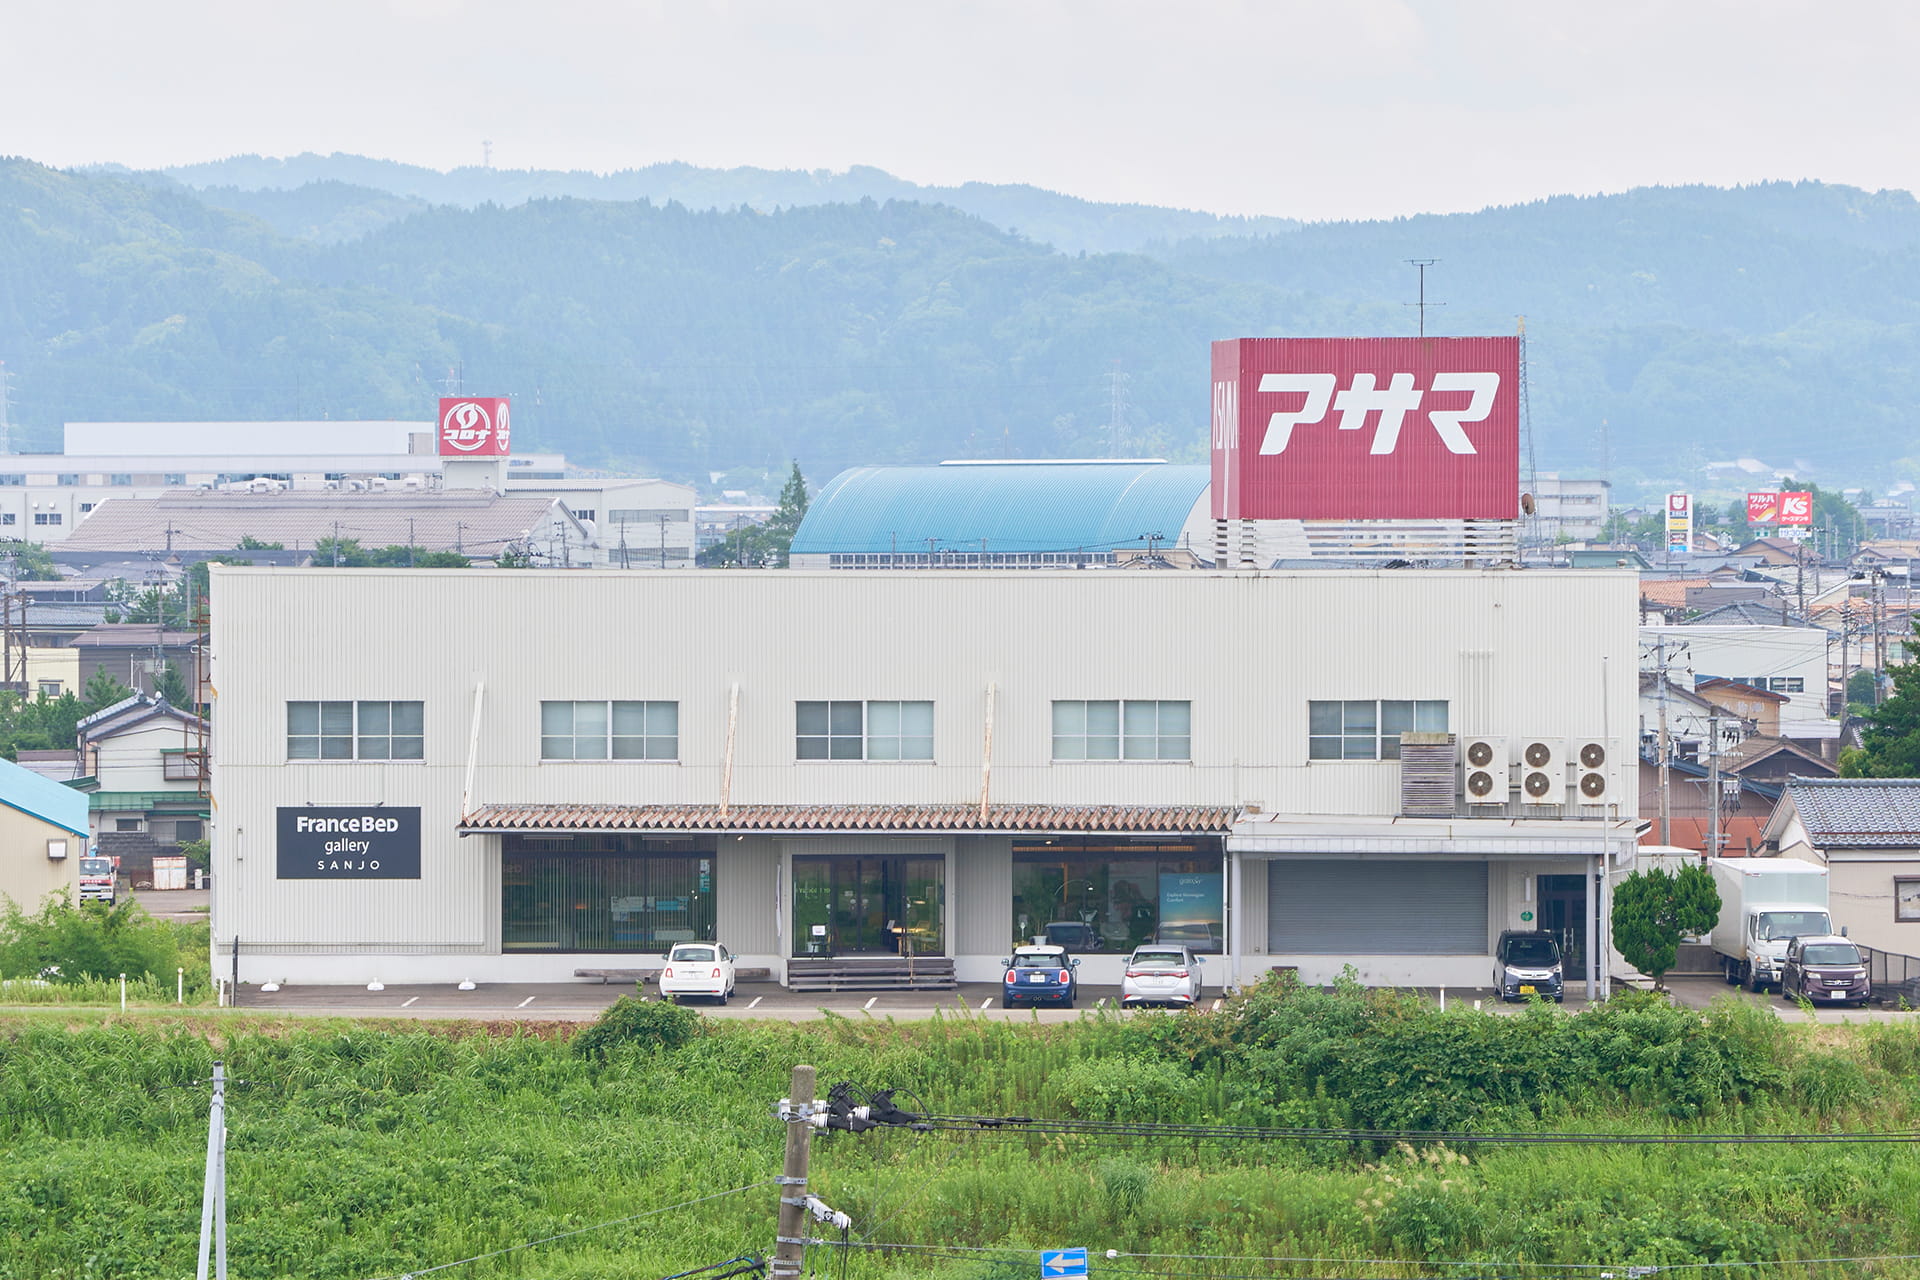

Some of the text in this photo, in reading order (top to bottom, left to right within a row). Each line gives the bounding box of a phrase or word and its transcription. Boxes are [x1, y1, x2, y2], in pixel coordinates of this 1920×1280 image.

[1258, 372, 1500, 455] アサマ
[443, 429, 491, 440] コロナ
[1749, 495, 1775, 503] ツルハ
[324, 837, 370, 855] gallery
[317, 860, 380, 870] SANJO
